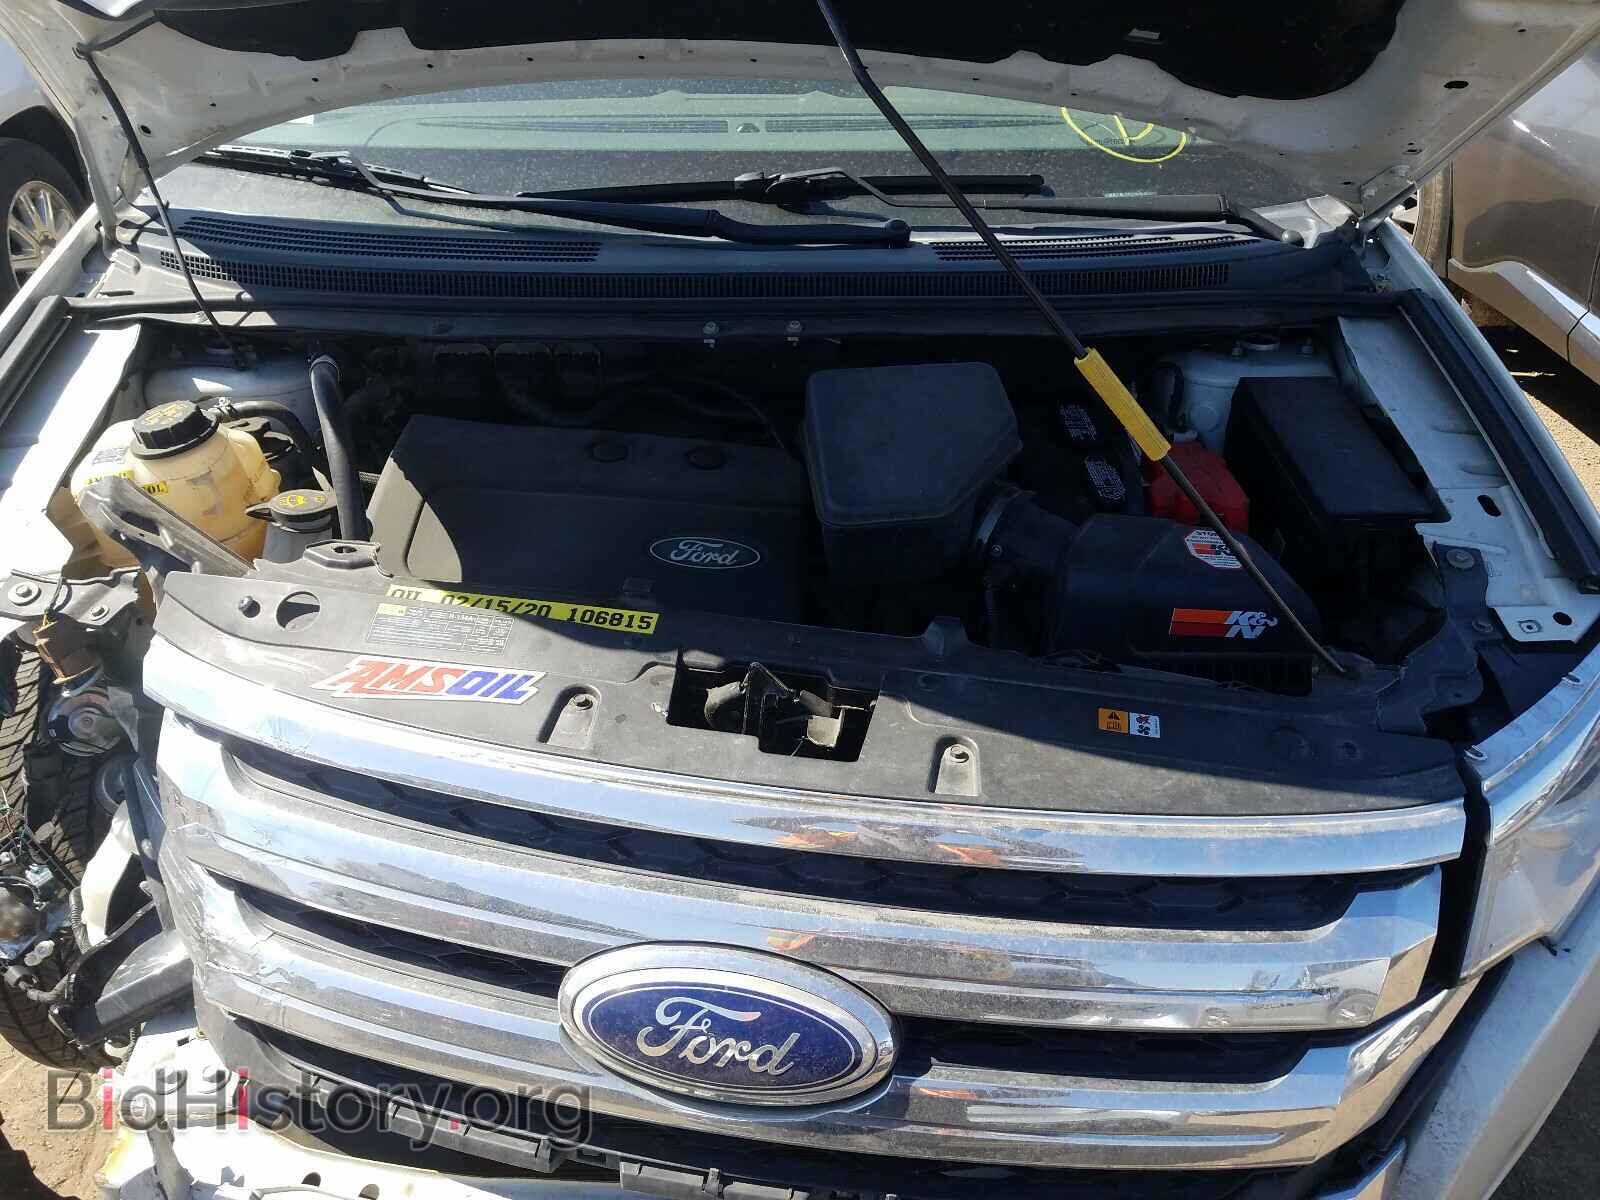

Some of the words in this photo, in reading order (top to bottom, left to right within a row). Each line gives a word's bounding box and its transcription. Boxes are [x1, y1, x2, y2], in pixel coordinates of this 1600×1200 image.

[670, 540, 739, 565] Ford
[568, 607, 654, 630] 106815
[328, 660, 537, 699] AMSOIL
[636, 997, 801, 1076] Ford
